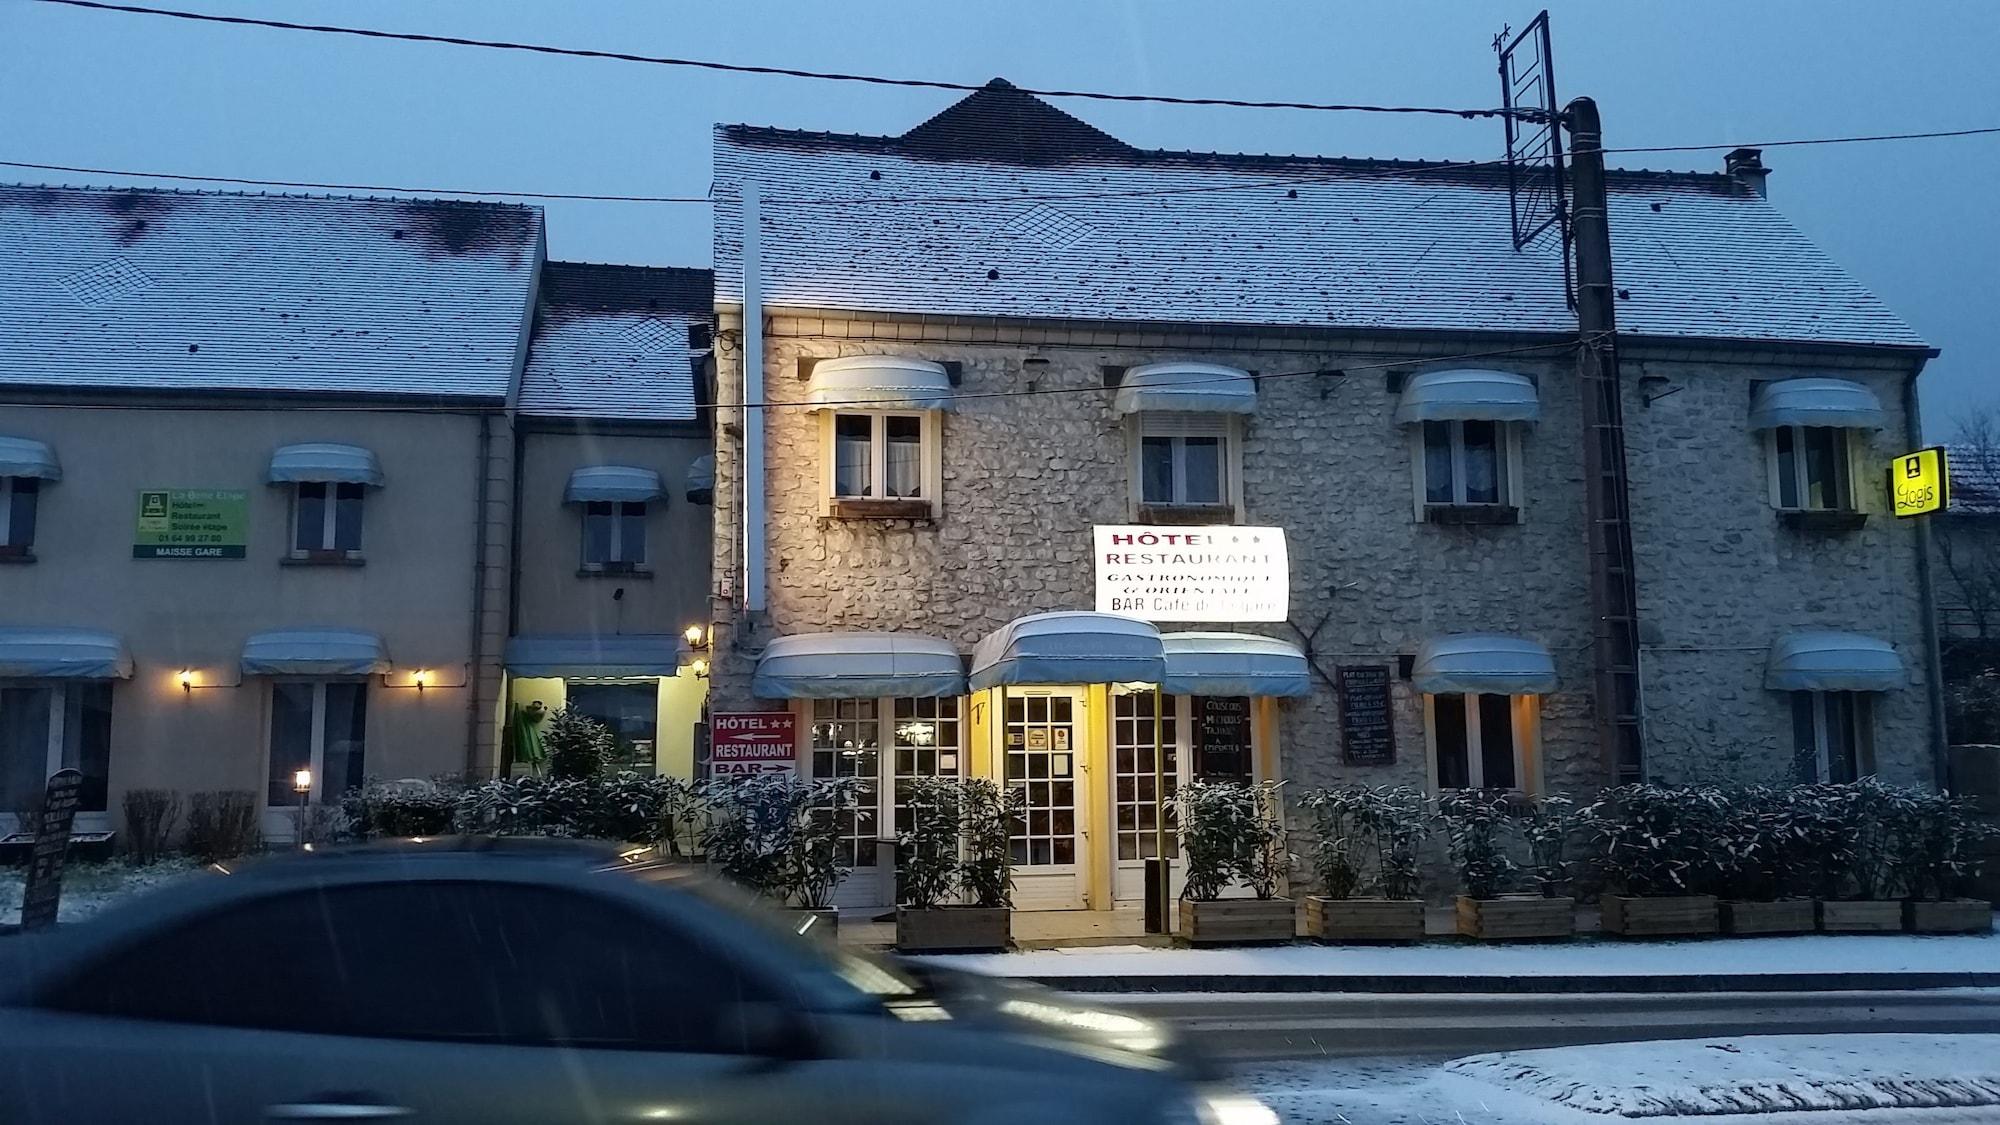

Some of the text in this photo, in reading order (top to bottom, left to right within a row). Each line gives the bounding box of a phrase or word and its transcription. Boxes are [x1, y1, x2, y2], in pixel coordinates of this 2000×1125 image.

[1897, 483, 1934, 509] Logis
[171, 512, 220, 520] Restaurant
[156, 548, 222, 556] MAISSE GARE
[1106, 553, 1271, 565] RESTAURANT
[1111, 597, 1145, 611] BAR
[715, 716, 768, 730] HÔTEL
[715, 743, 793, 758] RESTAURANT
[715, 763, 763, 774] BAR
